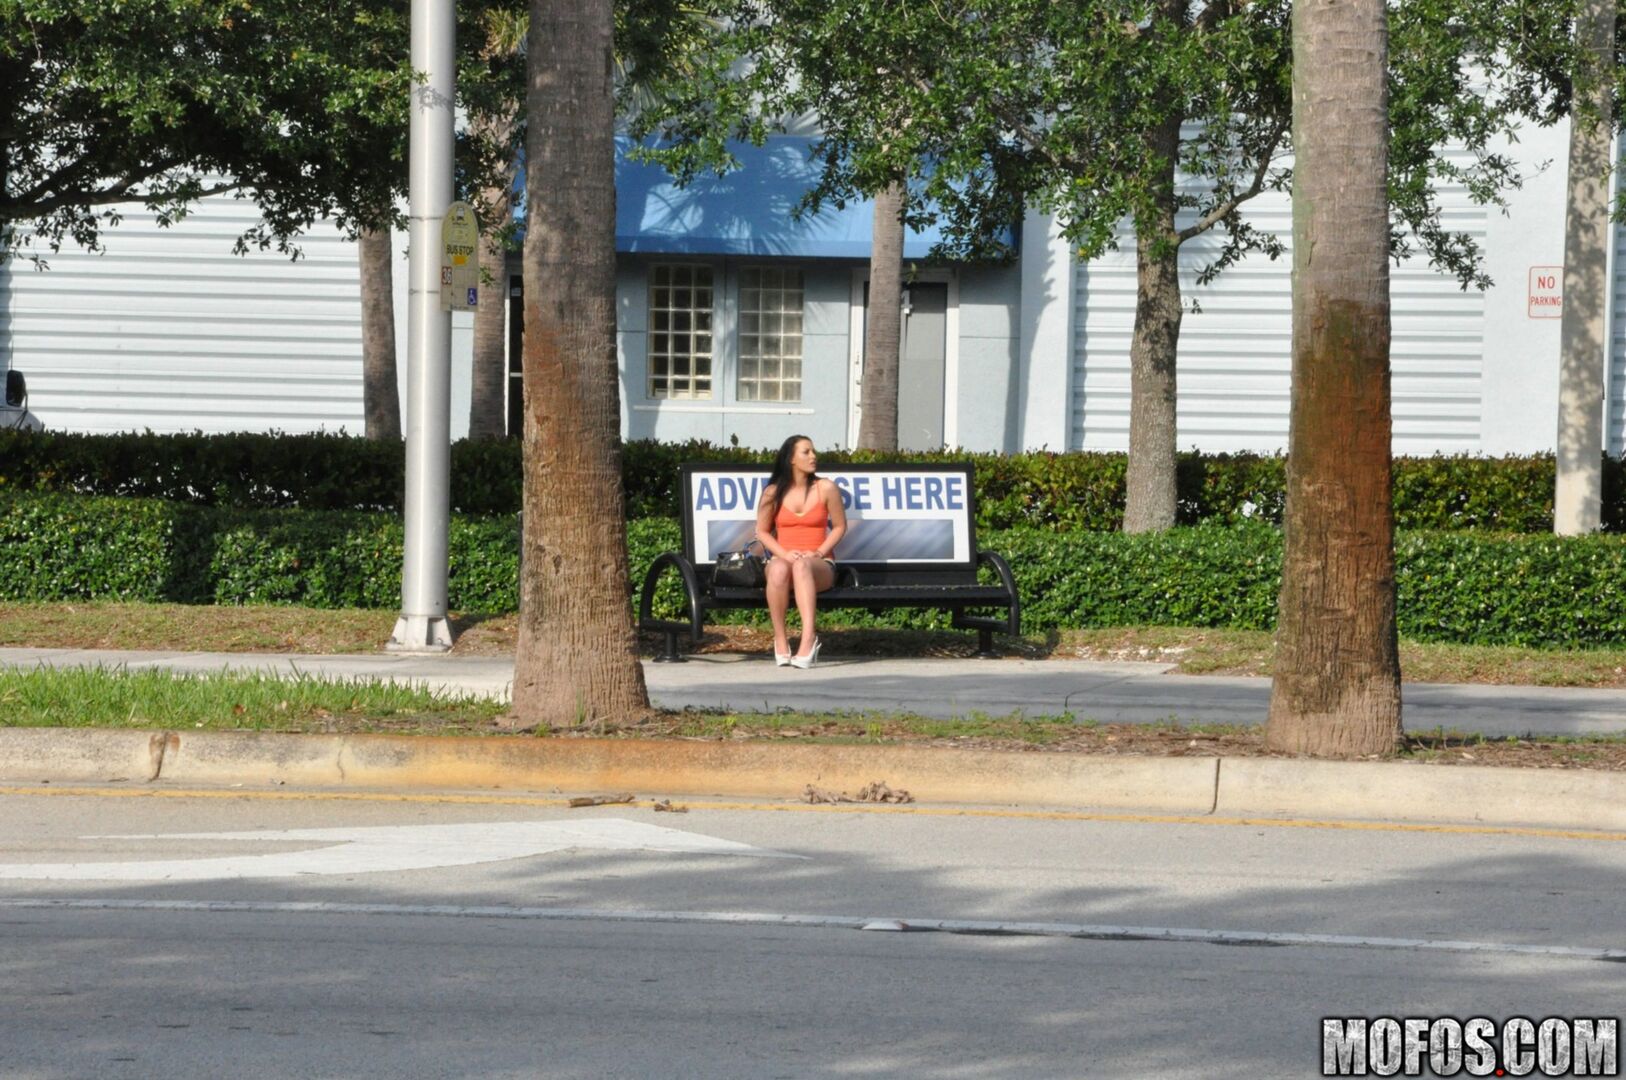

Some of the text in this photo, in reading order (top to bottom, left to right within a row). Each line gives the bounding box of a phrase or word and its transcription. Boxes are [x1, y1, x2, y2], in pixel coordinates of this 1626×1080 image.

[446, 244, 474, 256] BUS STOP
[1537, 276, 1556, 289] NO
[1530, 296, 1562, 306] PARKING
[696, 477, 963, 510] ADVSE HERE
